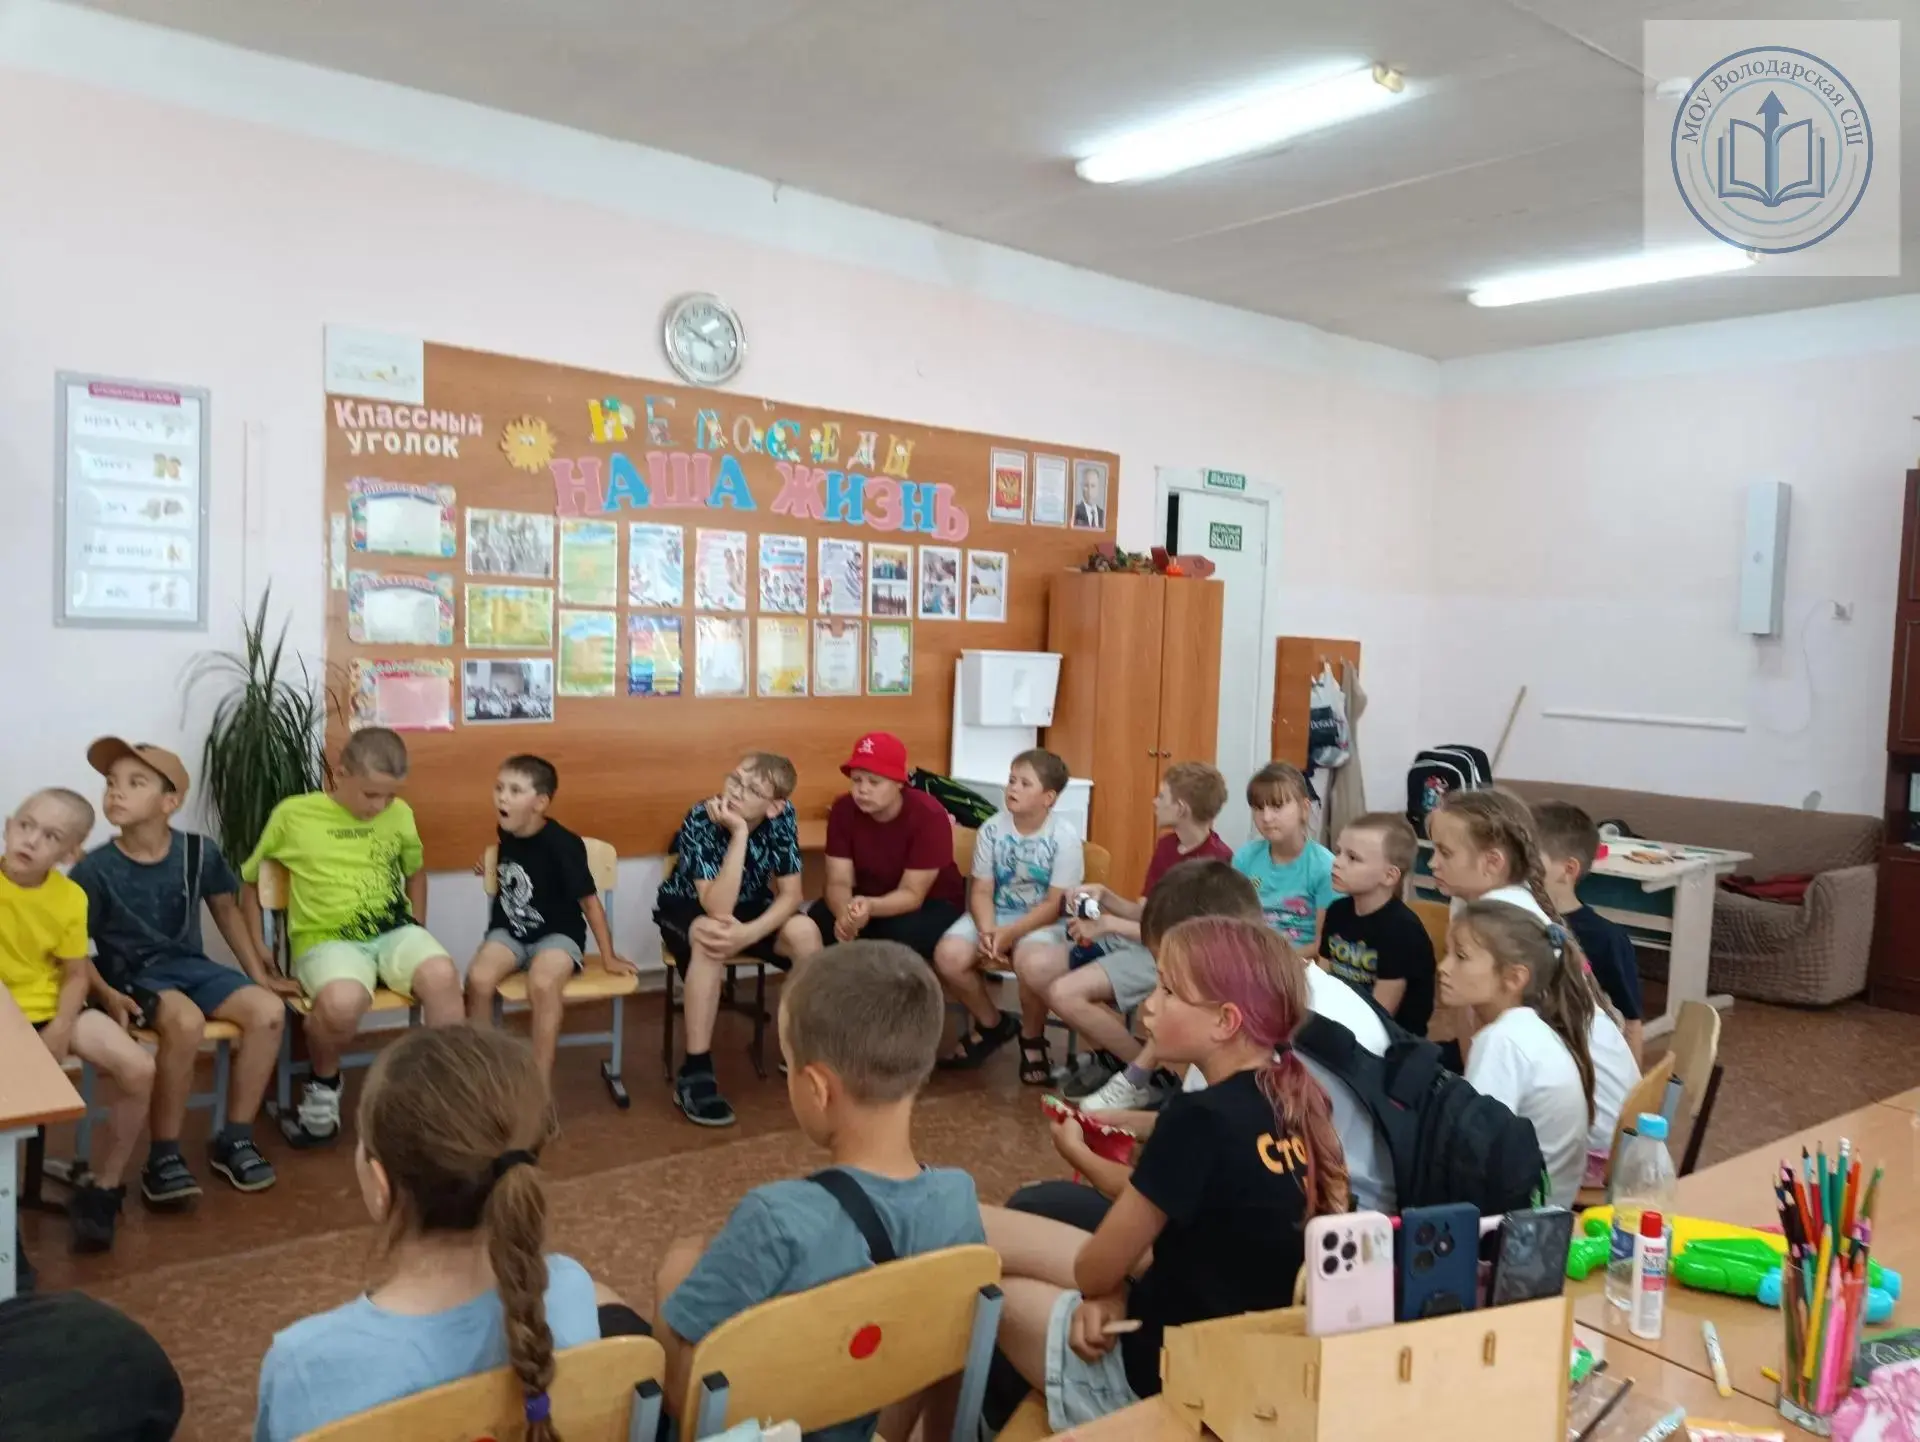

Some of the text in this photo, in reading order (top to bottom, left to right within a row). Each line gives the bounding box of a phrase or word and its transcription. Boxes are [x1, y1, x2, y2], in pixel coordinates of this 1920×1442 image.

[333, 399, 483, 437] Классный
[550, 451, 970, 542] НАША ЖИЗНЬ
[1210, 471, 1243, 488] ВЫХОД
[1210, 532, 1241, 550] ВЫХОД
[1257, 1133, 1309, 1174] СТО
